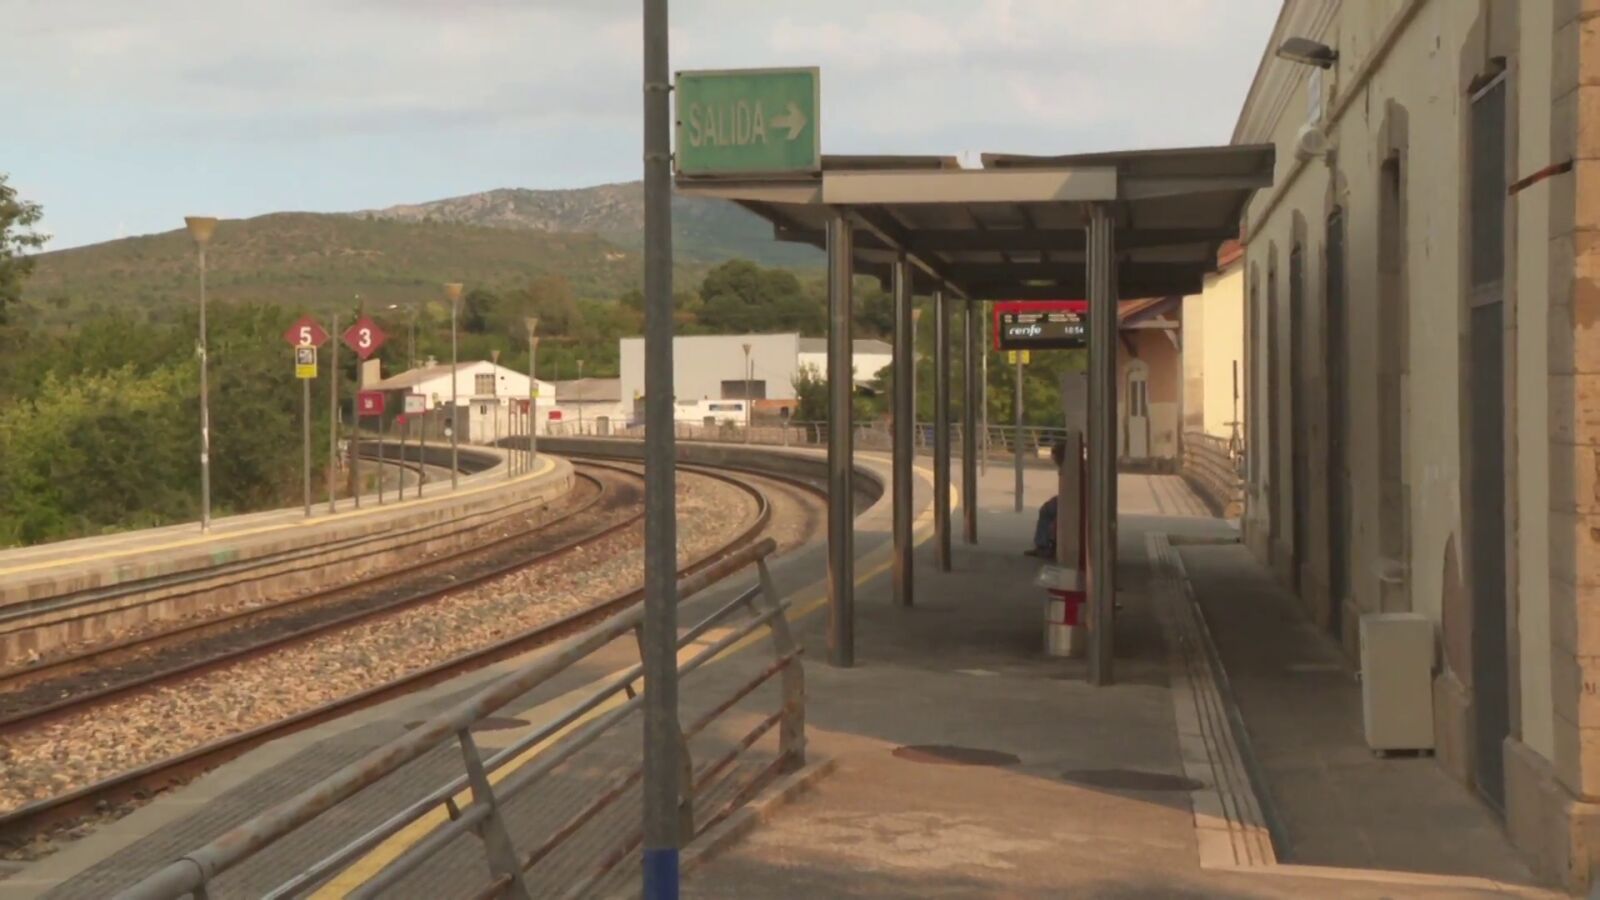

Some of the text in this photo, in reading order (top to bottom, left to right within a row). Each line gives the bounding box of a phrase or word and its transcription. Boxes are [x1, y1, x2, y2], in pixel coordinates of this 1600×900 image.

[689, 98, 767, 147] SALIDA
[300, 326, 312, 345] 5
[359, 329, 372, 348] 3
[1009, 324, 1042, 337] renfe
